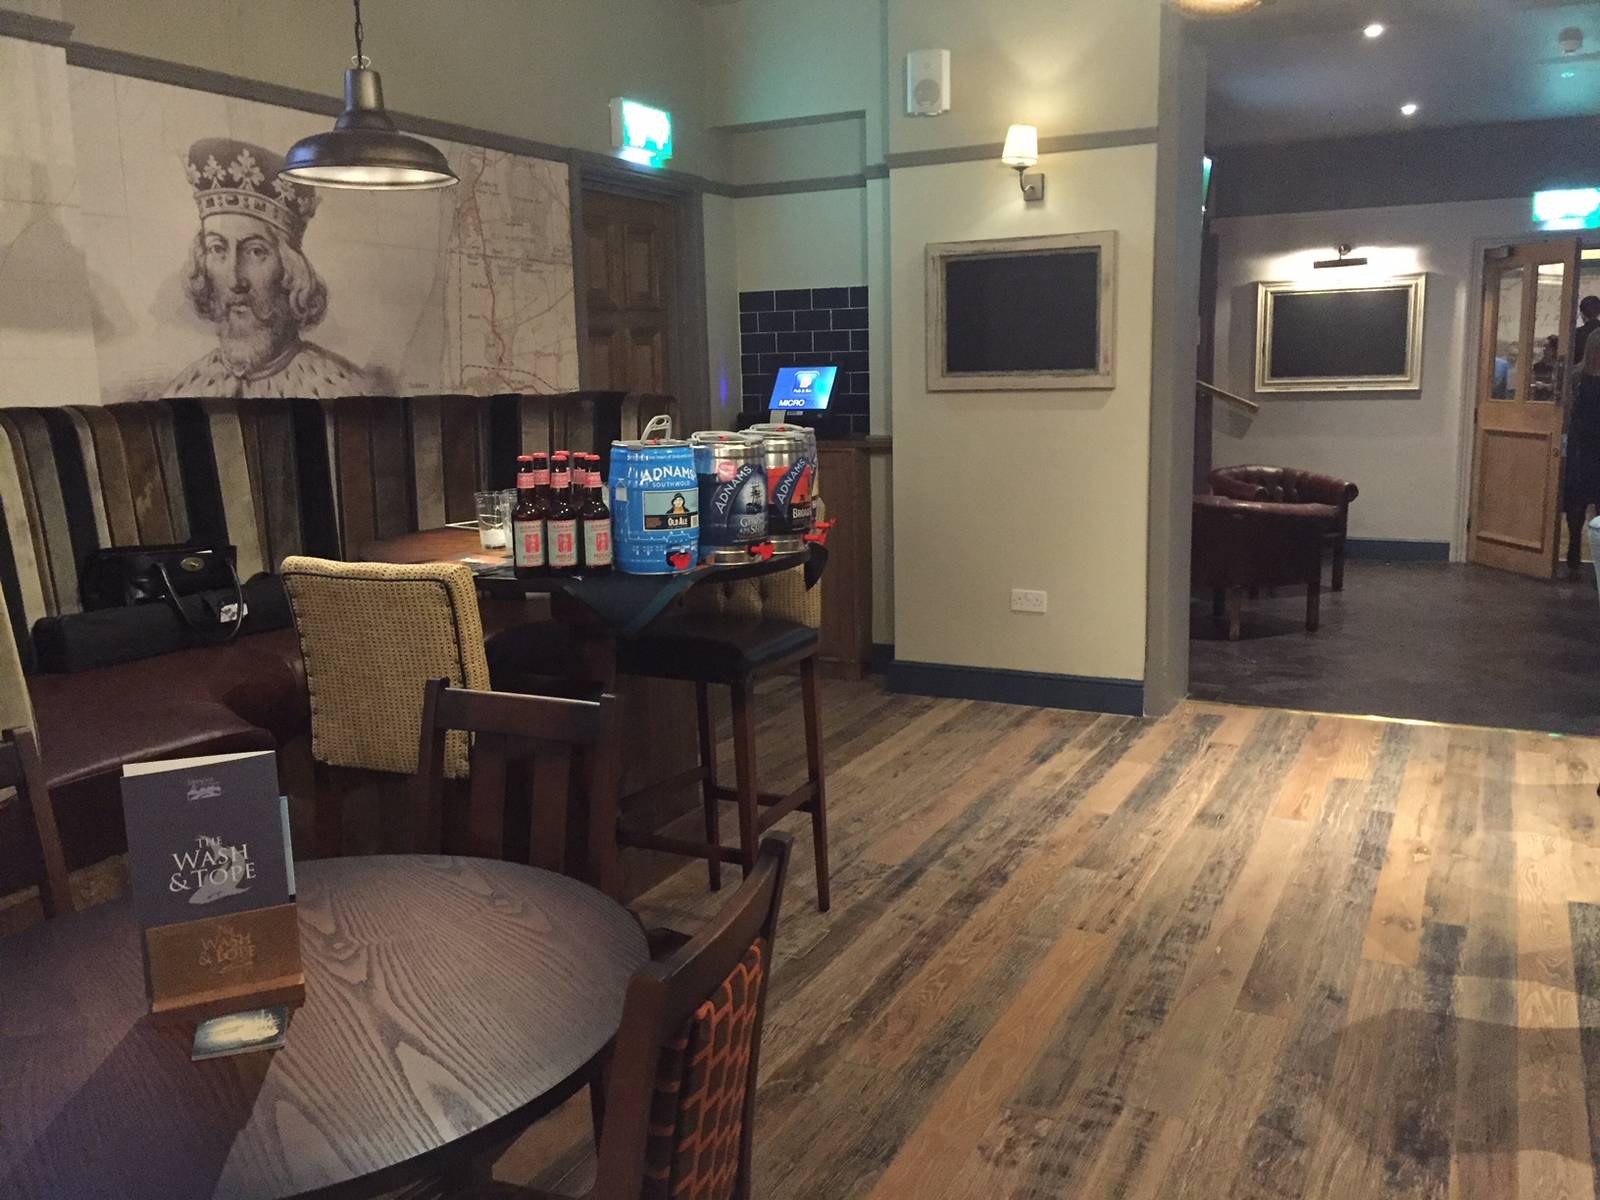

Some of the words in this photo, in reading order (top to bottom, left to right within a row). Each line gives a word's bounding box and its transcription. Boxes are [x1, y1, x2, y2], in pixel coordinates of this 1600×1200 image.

[778, 399, 806, 407] MICRO
[639, 465, 697, 486] ADNAMS
[775, 458, 806, 505] ADNAMS
[715, 465, 753, 515] ADNAMS
[195, 834, 223, 849] THE
[172, 843, 249, 872] WASH
[169, 872, 192, 893] &
[190, 861, 257, 889] TOPE
[200, 932, 252, 951] WASH
